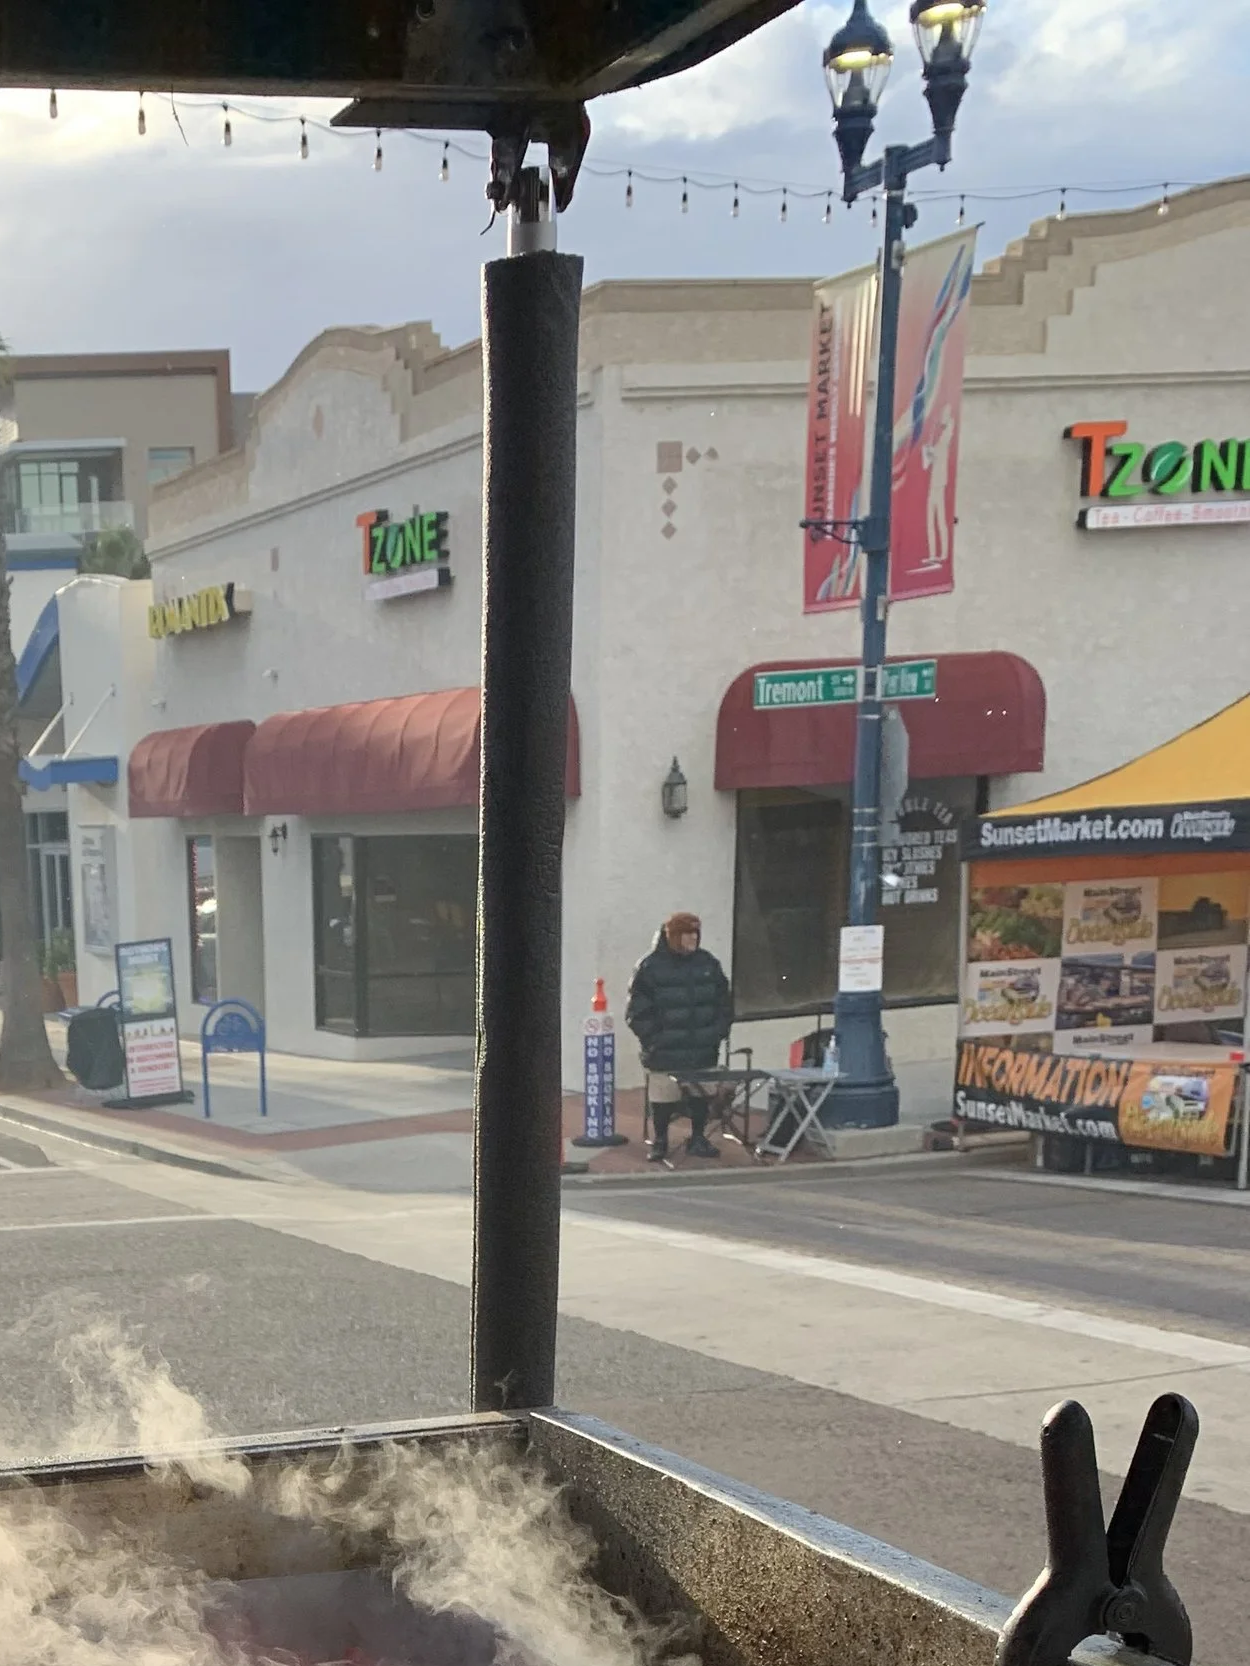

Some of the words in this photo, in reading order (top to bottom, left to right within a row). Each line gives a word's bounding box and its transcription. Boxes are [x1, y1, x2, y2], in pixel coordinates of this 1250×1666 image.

[816, 303, 833, 420] MARKET
[356, 511, 438, 576] TZONE
[757, 674, 825, 704] Tremont
[981, 815, 1163, 847] SunsetMarket.com
[980, 967, 1042, 978] MainStreet
[587, 1037, 599, 1058] NO
[603, 1036, 613, 1057] NO
[957, 1042, 1129, 1108] INFORMATION
[587, 1062, 599, 1139] SMOKING
[955, 1090, 1118, 1140] SunsetMarket.com
